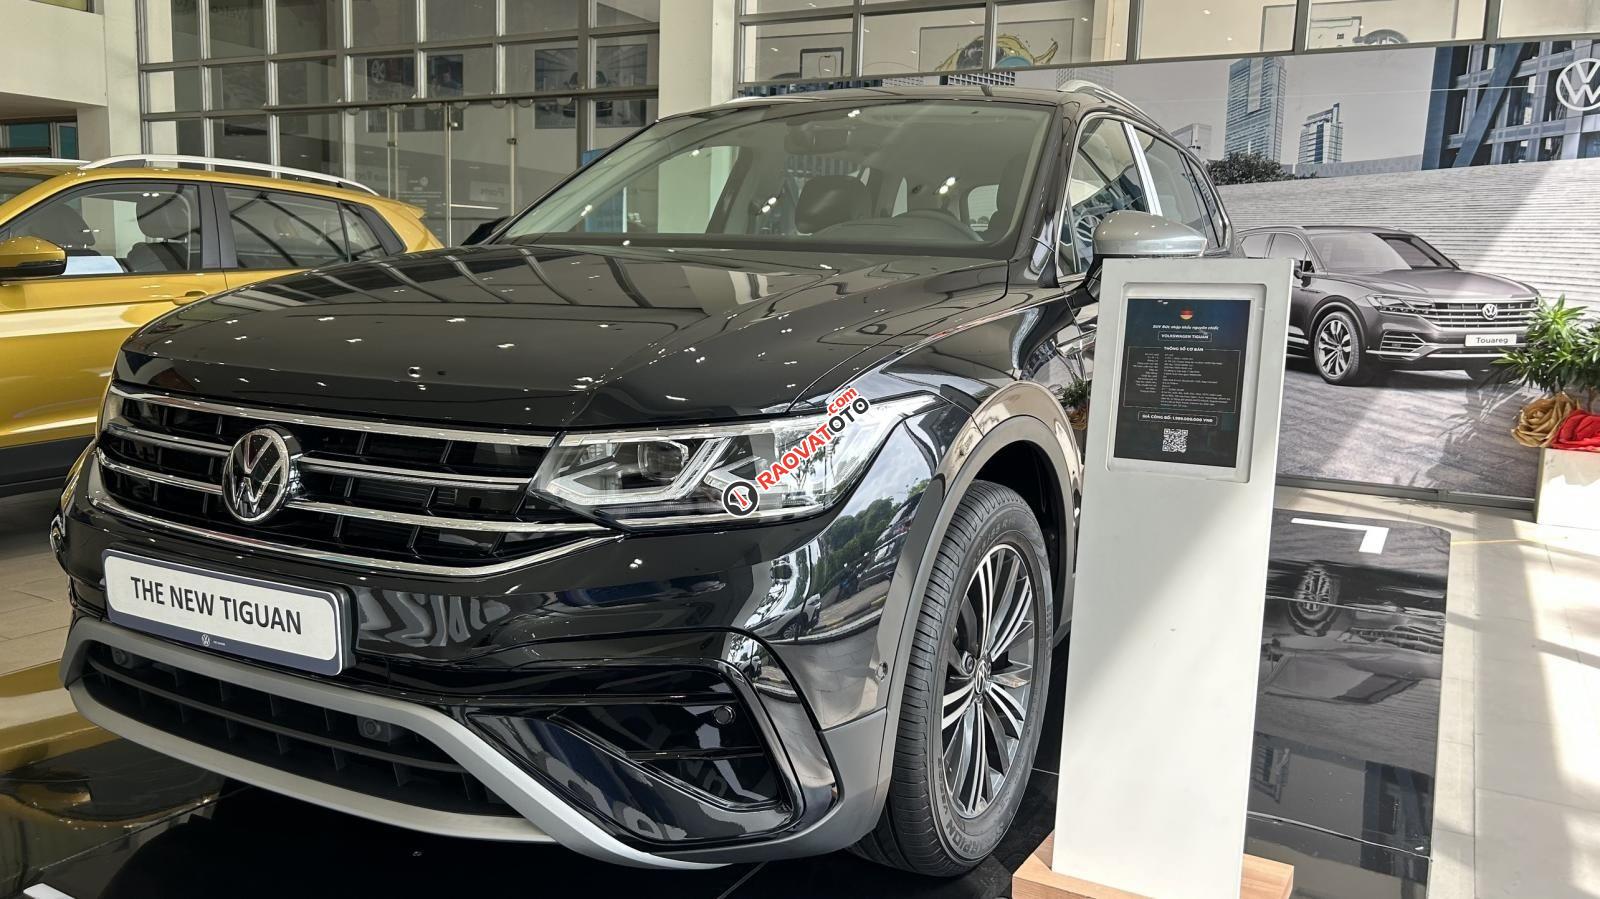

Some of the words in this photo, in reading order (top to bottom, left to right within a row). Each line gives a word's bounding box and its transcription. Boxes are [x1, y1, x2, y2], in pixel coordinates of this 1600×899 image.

[130, 576, 166, 605] THE
[169, 585, 214, 616] NEW
[219, 596, 302, 635] TIGUAN
